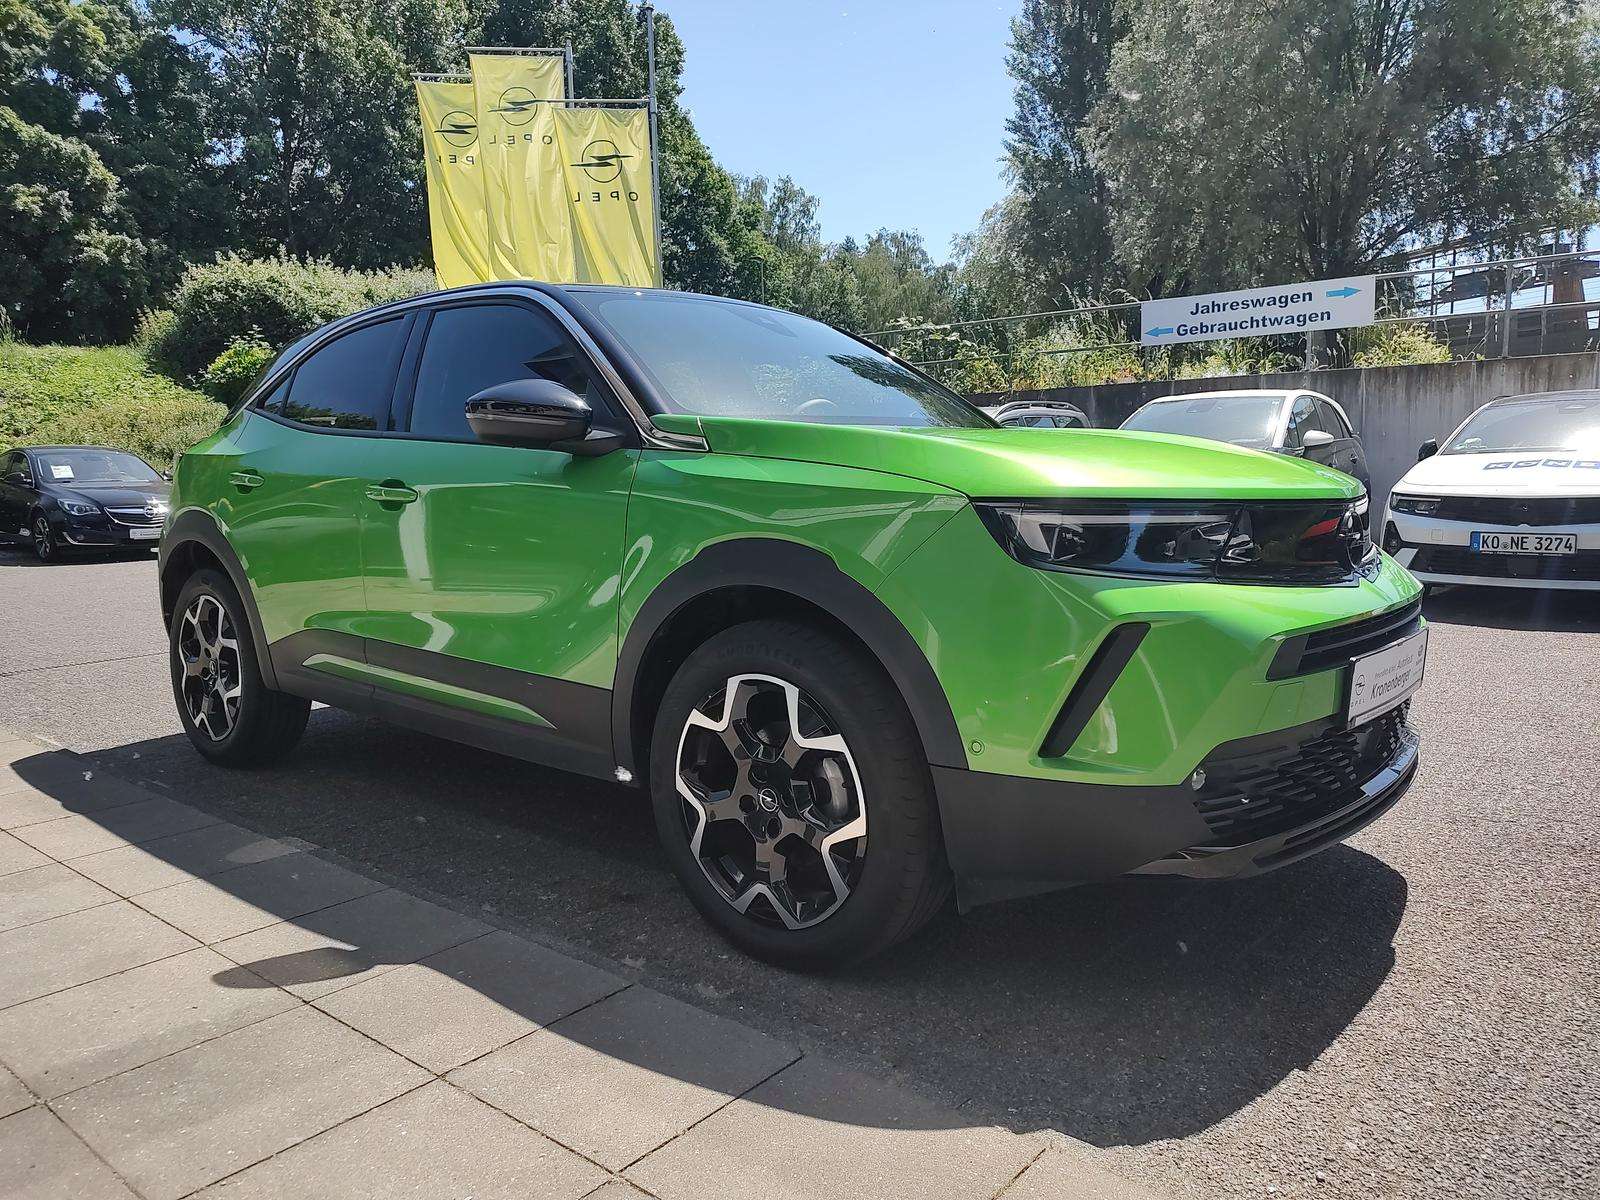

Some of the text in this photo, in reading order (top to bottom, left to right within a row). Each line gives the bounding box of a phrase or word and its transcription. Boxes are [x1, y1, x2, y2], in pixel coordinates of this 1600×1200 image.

[1190, 291, 1313, 316] Jahreswagen
[1176, 310, 1331, 337] Gebrauchtwagen
[1481, 535, 1573, 552] KO NE 3274
[1370, 669, 1412, 699] Kronenberger
